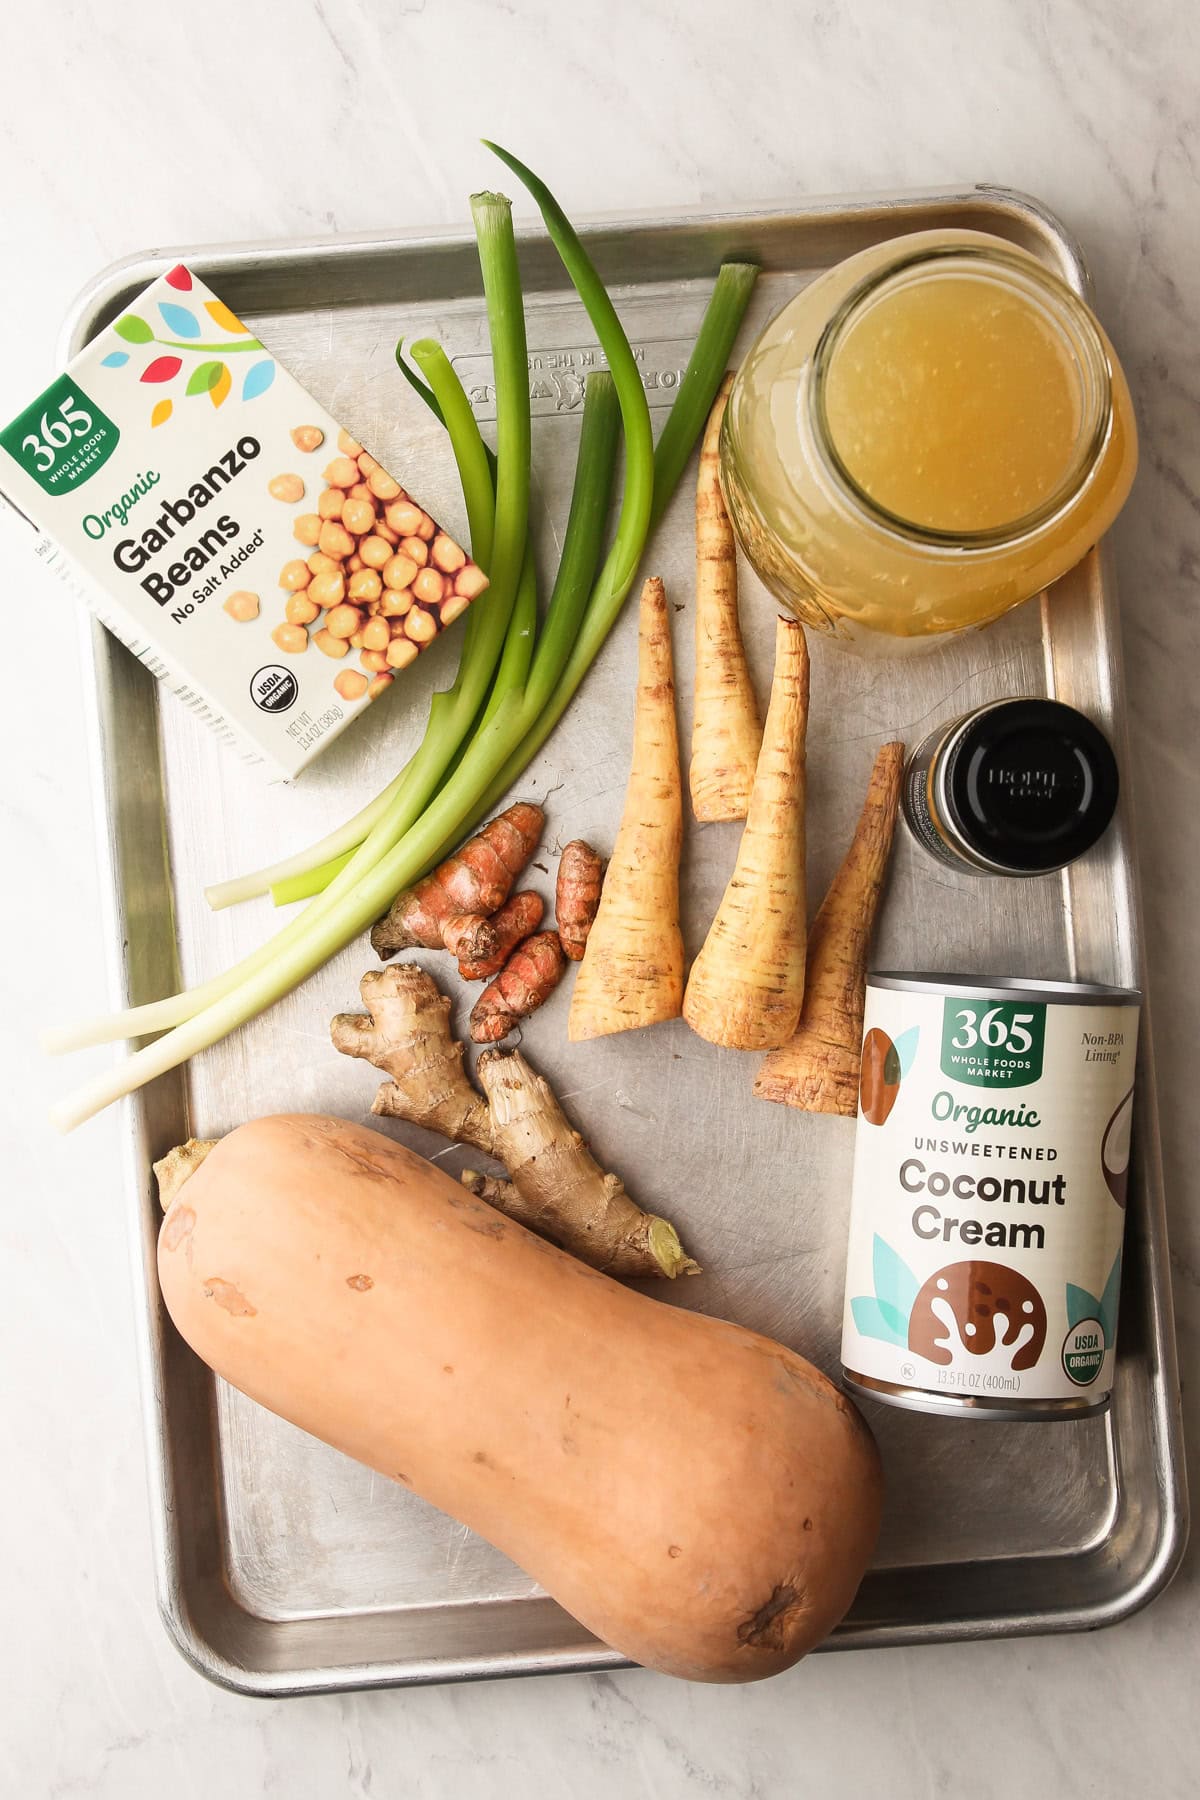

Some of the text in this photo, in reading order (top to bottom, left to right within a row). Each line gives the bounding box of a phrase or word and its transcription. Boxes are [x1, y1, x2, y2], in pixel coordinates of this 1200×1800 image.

[548, 353, 575, 368] THE
[580, 352, 594, 365] IN
[22, 395, 93, 472] 365
[48, 429, 107, 483] WHOLE FOODS
[68, 447, 102, 480] MARKET
[82, 470, 161, 540] Organic
[113, 436, 261, 573] Garbanzo
[140, 515, 240, 607] Beans
[170, 603, 195, 624] No
[192, 575, 222, 604] Salt
[257, 673, 282, 696] USDA
[265, 679, 293, 707] ORGANIC
[286, 710, 313, 739] NET WT
[297, 704, 345, 751] 13.4 OZ (380g)
[951, 1007, 1034, 1054] 365
[1081, 1032, 1124, 1046] Non-BPA
[951, 1055, 1031, 1069] WHOLE FOODS
[967, 1067, 1014, 1079] MARKET
[931, 1091, 1041, 1133] Organic
[914, 1136, 1058, 1161] UNSWEETENED
[899, 1158, 1067, 1205] Coconut
[911, 1205, 1045, 1249] Cream
[1074, 1333, 1099, 1350] USDA
[1069, 1355, 1100, 1368] ORGANIC
[938, 1370, 1021, 1392] 13.5 FL OZ (400mL)
